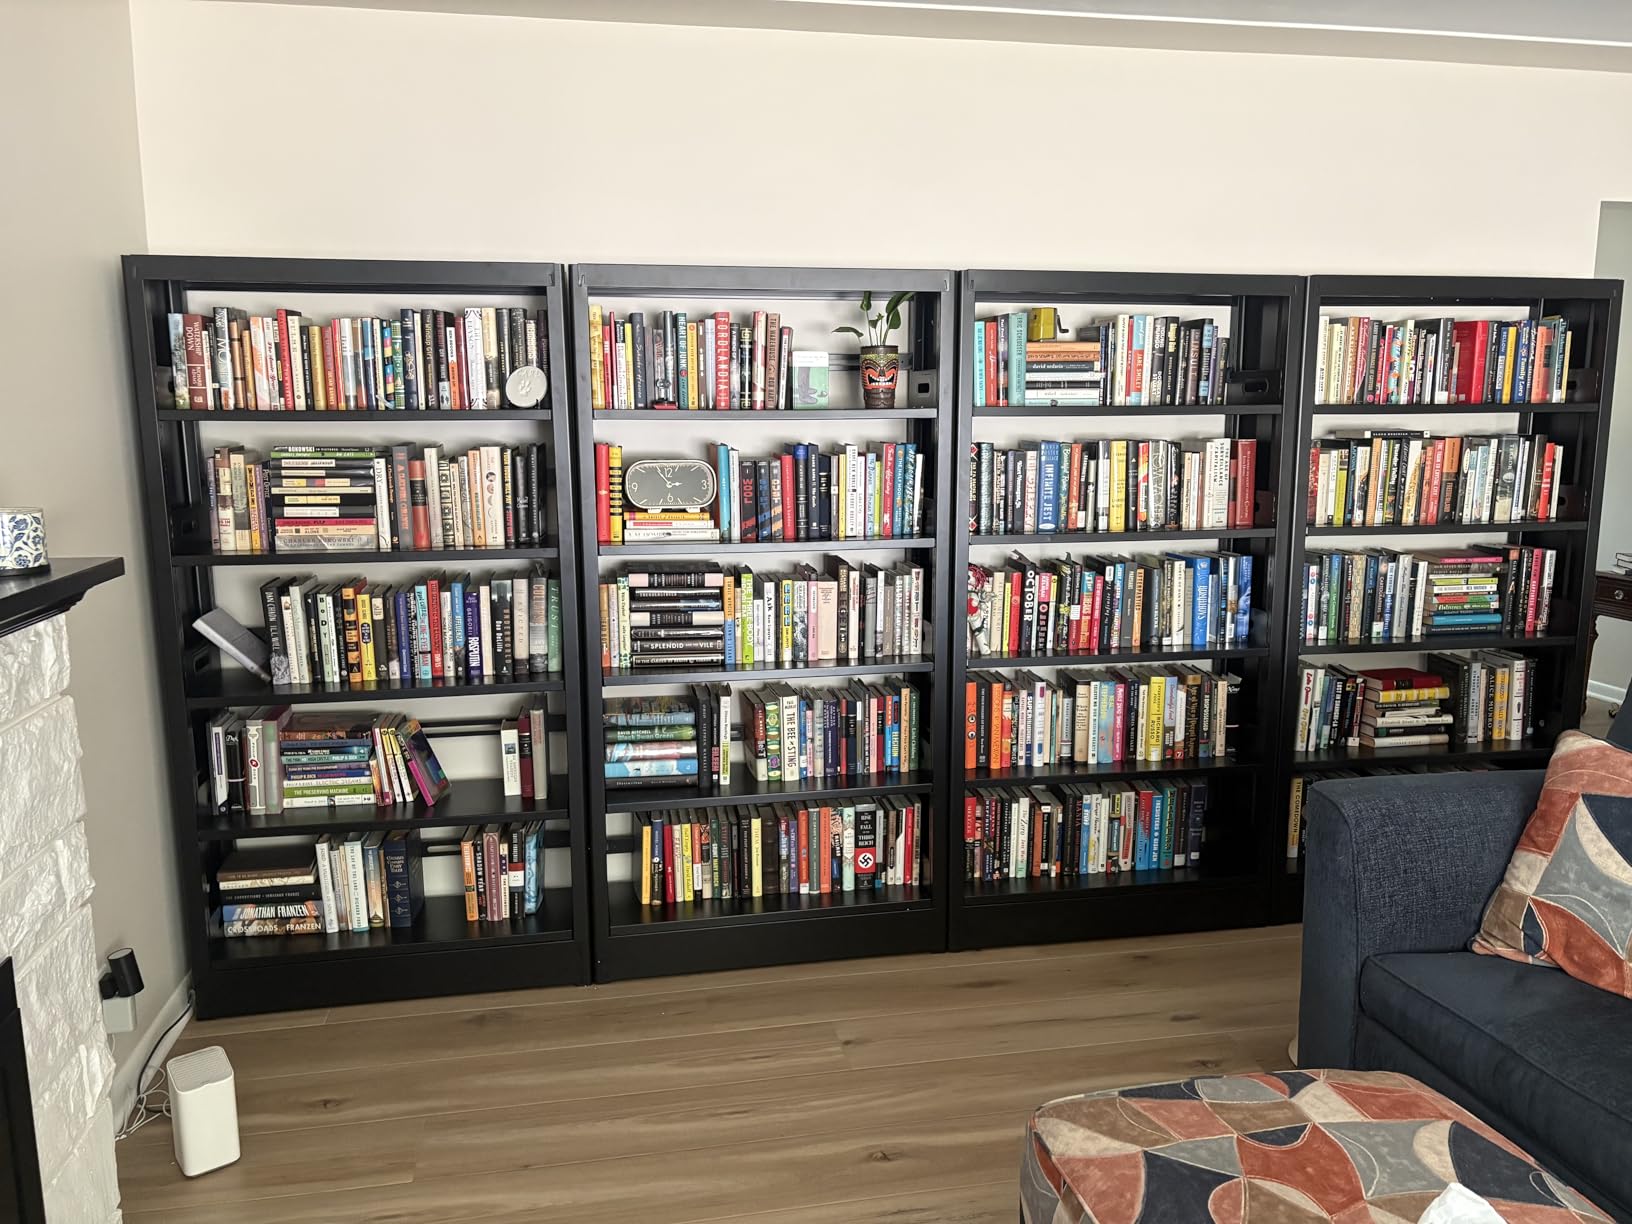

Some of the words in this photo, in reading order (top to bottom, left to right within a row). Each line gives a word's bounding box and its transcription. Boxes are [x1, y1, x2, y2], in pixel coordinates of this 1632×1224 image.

[186, 327, 195, 351] DOWN
[193, 322, 202, 356] WATERSHIP
[679, 340, 685, 348] OF
[768, 330, 776, 361] WAREHOUSE
[717, 317, 729, 389] FORDLANDIA
[1507, 444, 1515, 470] TERROR
[376, 468, 384, 483] DRY
[665, 468, 672, 477] 12
[1044, 464, 1054, 500] INFINITE
[632, 483, 638, 492] 9
[701, 480, 707, 489] 3
[667, 493, 673, 502] 6
[1043, 502, 1052, 520] JEST
[265, 592, 273, 603] DAN
[1024, 570, 1035, 621] OCTOBER
[551, 587, 559, 628] TRUST
[269, 626, 277, 635] ILL
[271, 636, 279, 650] WILL
[469, 637, 480, 666] RASPUTIN
[994, 685, 1002, 714] LESSONS
[787, 712, 795, 725] THE
[1332, 703, 1341, 727] SHANGRI-LA
[787, 728, 795, 739] BEE
[787, 746, 796, 767] STING
[1293, 794, 1301, 833] COMEDOWN
[240, 906, 275, 919] JONATHAN
[278, 905, 309, 918] FRANZEN
